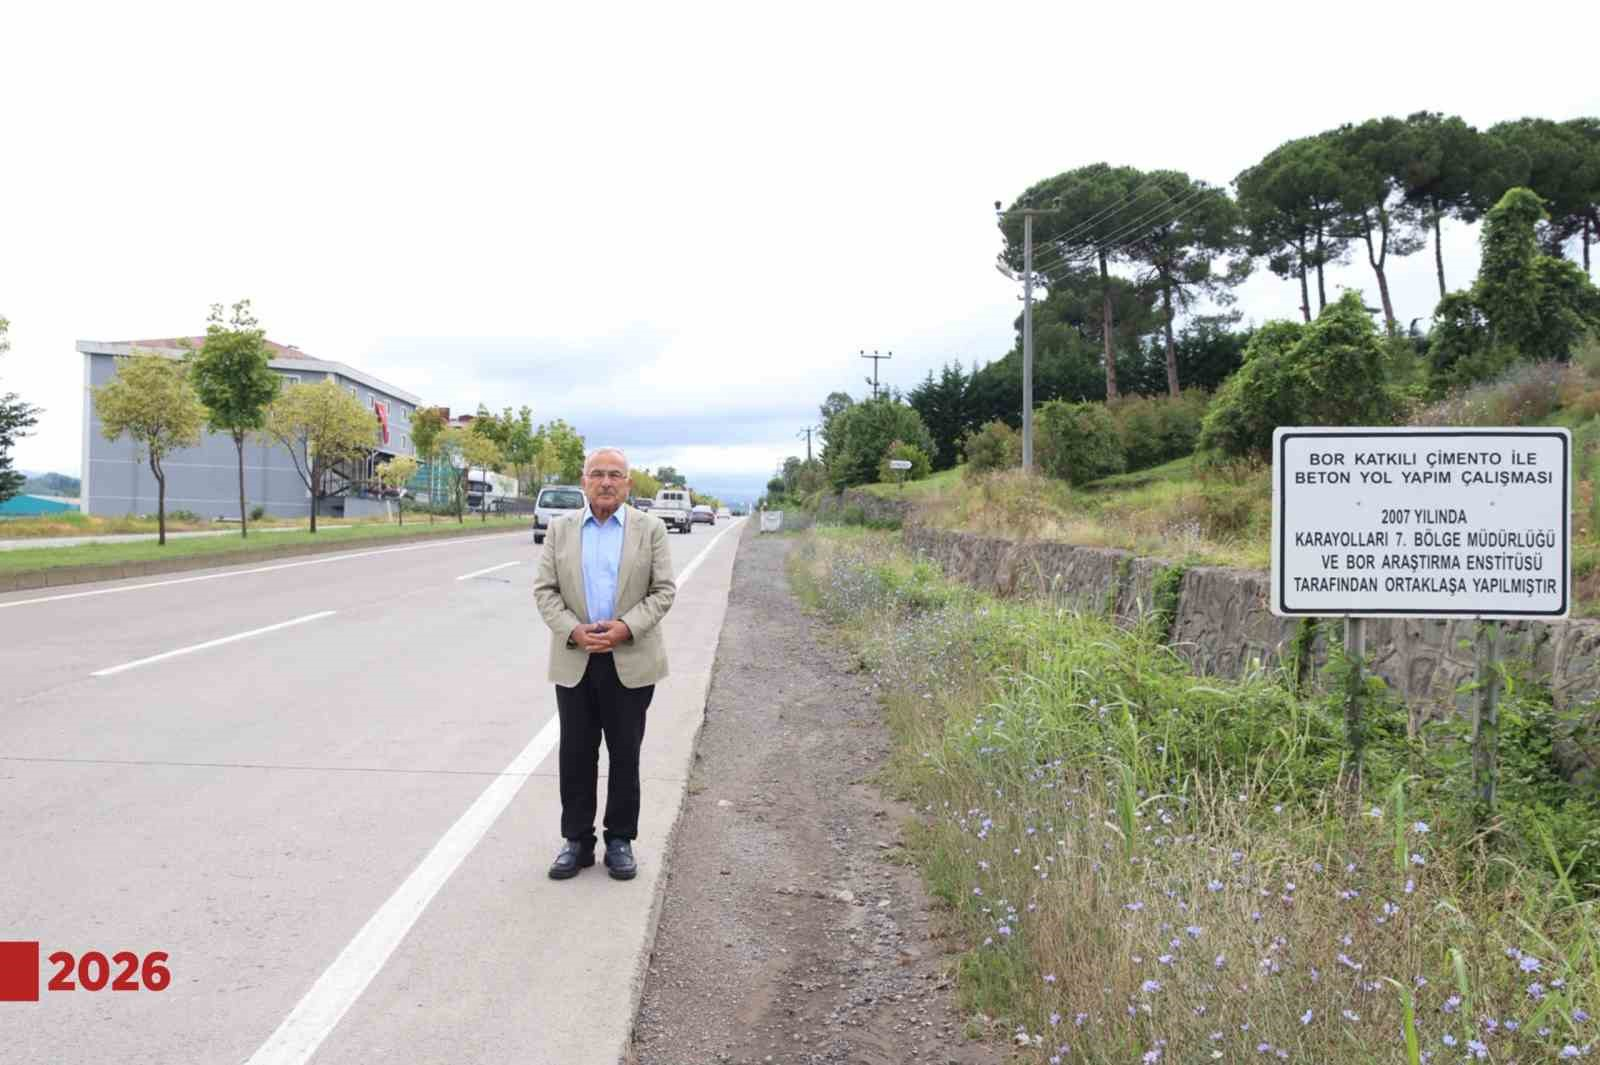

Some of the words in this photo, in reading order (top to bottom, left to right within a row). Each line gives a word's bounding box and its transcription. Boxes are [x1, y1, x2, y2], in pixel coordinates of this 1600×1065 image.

[1310, 453, 1344, 466] BOR
[1355, 453, 1416, 465] KATKILI
[1426, 450, 1501, 468] ÇİMENTO
[1512, 450, 1536, 465] İLE
[1296, 471, 1350, 484] BETON
[1360, 471, 1392, 484] YOL
[1402, 471, 1451, 484] YAPIM
[1461, 471, 1552, 487] ÇALIŞMASI
[1381, 509, 1410, 524] 2007
[1414, 509, 1467, 524] YILINDA
[1296, 532, 1388, 547] KARAYOLLARI
[1396, 532, 1406, 546] 7.
[1414, 529, 1461, 547] BÖLGE
[1467, 528, 1555, 548] MÜDÜRLÜĞÜ
[1321, 554, 1339, 569] VE
[1347, 554, 1375, 569] BOR
[1381, 554, 1461, 573] ARAŞTIRMA
[1467, 552, 1542, 571] ENSTİTÜSÜ
[1294, 577, 1377, 592] TARAFINDAN
[1385, 577, 1467, 596] ORTAKLAŞA
[1473, 576, 1557, 597] YAPILMIŞTIR
